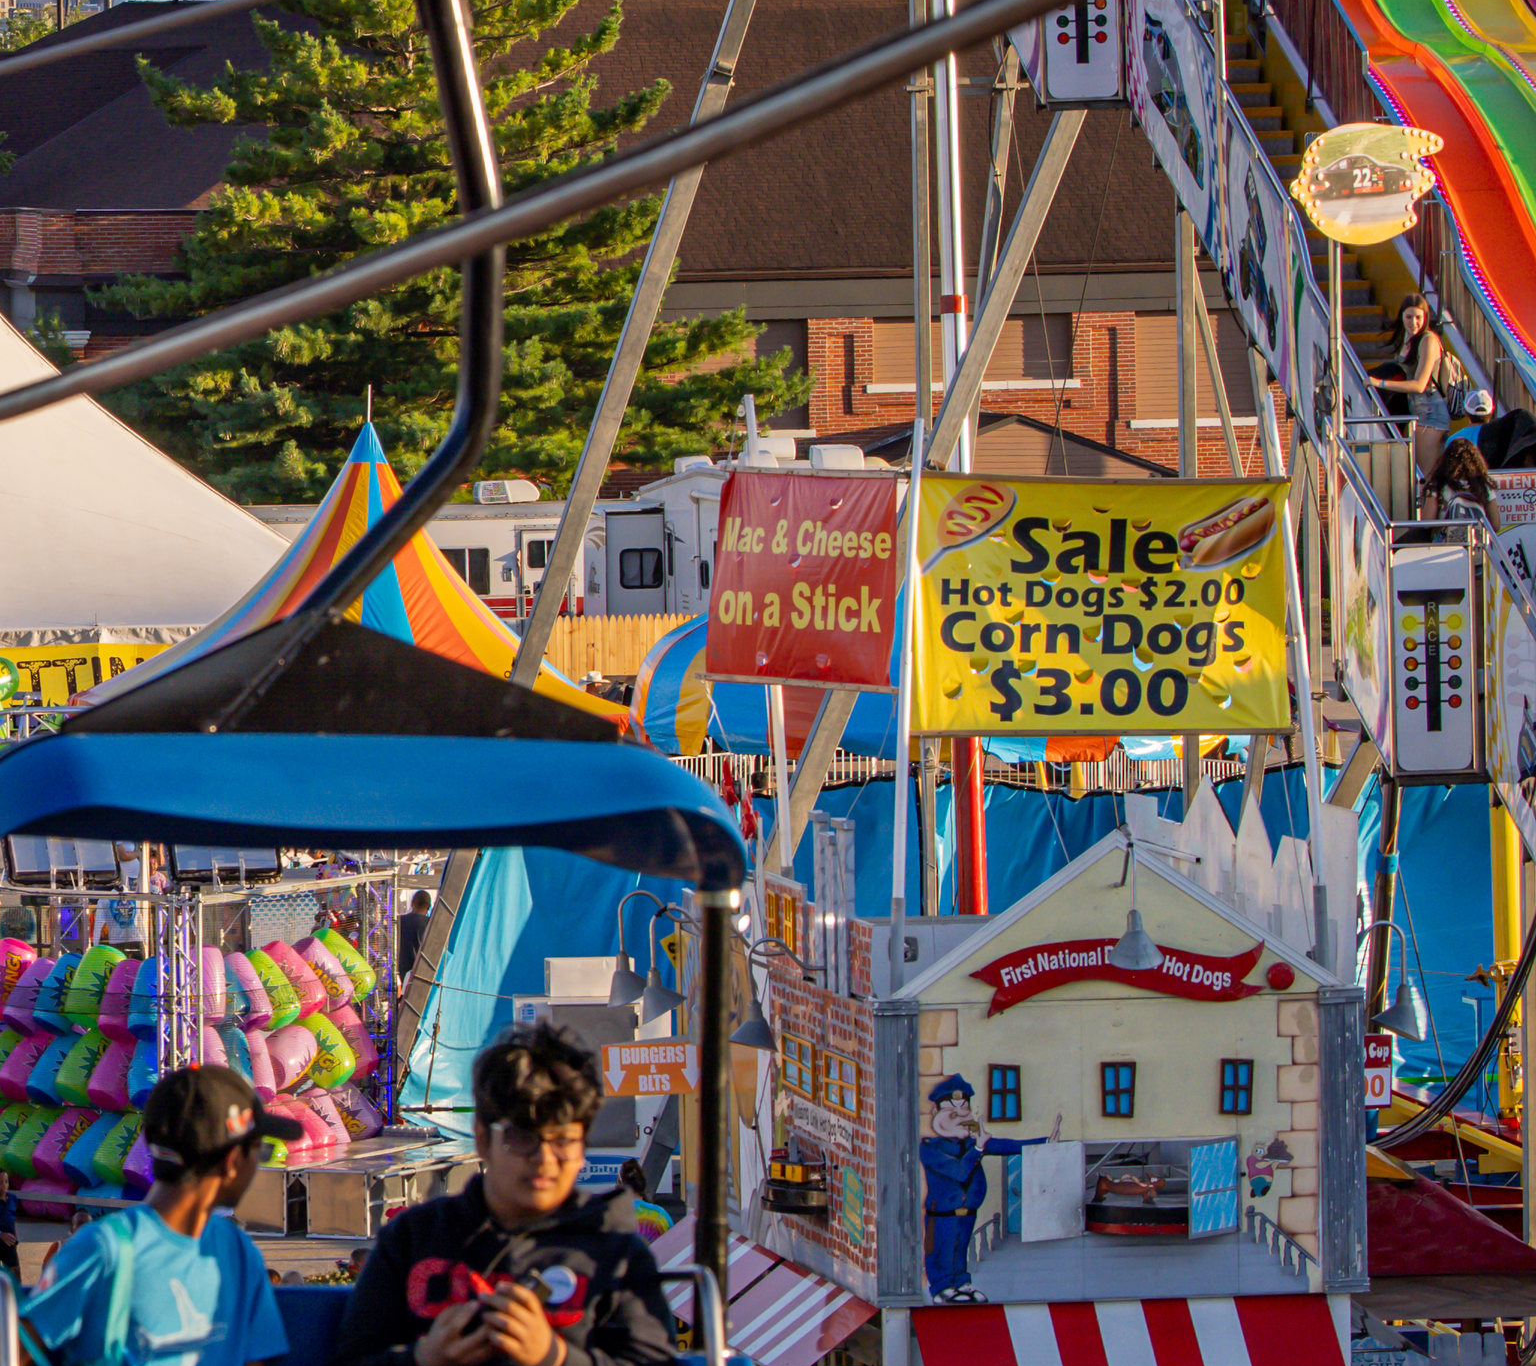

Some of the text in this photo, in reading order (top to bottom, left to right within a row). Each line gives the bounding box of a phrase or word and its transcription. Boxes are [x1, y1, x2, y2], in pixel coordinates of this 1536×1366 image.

[1353, 169, 1372, 187] 22
[722, 517, 892, 560] Mac & Cheese
[1010, 516, 1179, 575] Sale
[719, 583, 882, 633] on a Stick
[940, 576, 1245, 615] Hot Dogs $2.00
[940, 610, 1246, 667] Corn Dogs
[989, 665, 1189, 722] $3.00
[999, 947, 1104, 988] First National
[1162, 957, 1232, 991] Hot Dogs
